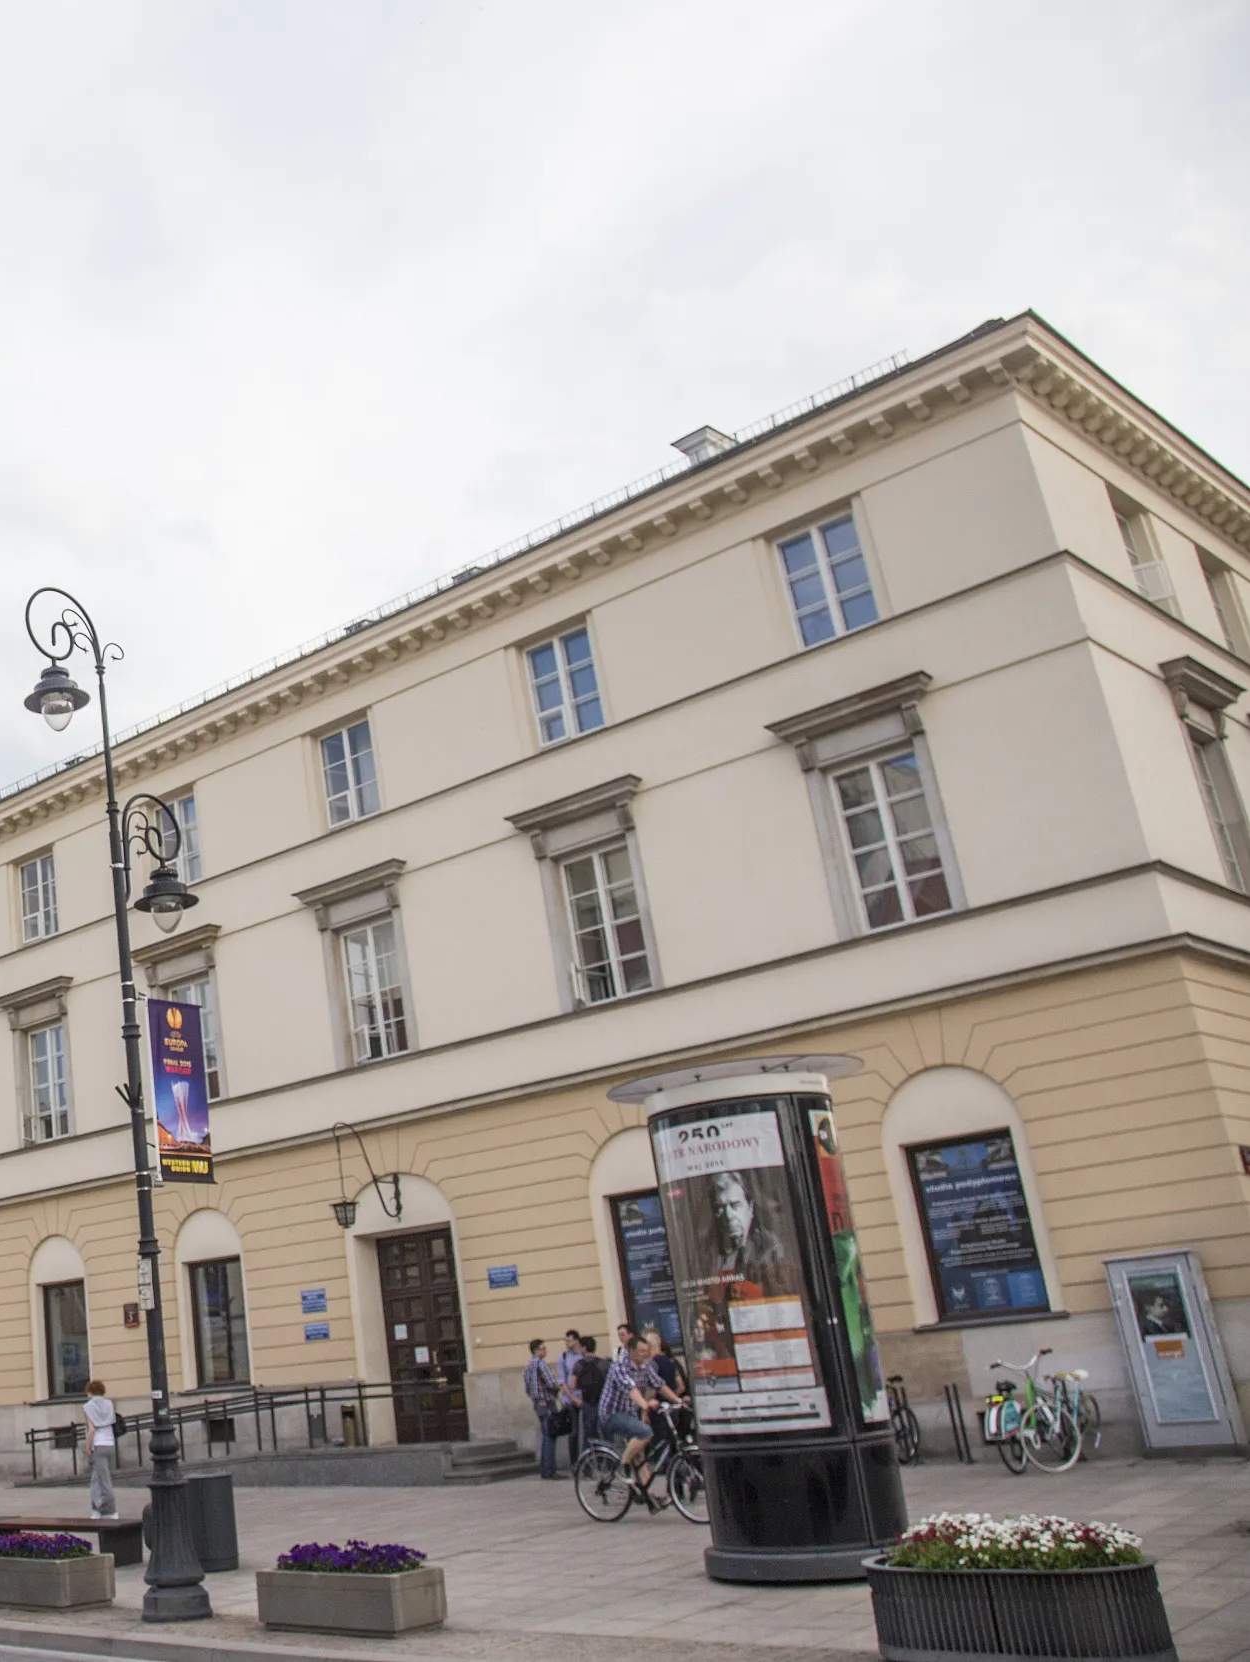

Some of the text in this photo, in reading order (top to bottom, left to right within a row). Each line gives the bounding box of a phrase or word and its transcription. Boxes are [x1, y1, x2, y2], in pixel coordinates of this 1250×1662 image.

[164, 1038, 188, 1048] EUROPA
[163, 1058, 179, 1067] FINAL
[678, 1125, 720, 1144] 250
[689, 1134, 761, 1158] NARODOWY
[161, 1158, 190, 1167] WESTERN
[171, 1165, 190, 1173] UNION
[925, 1182, 954, 1193] studia
